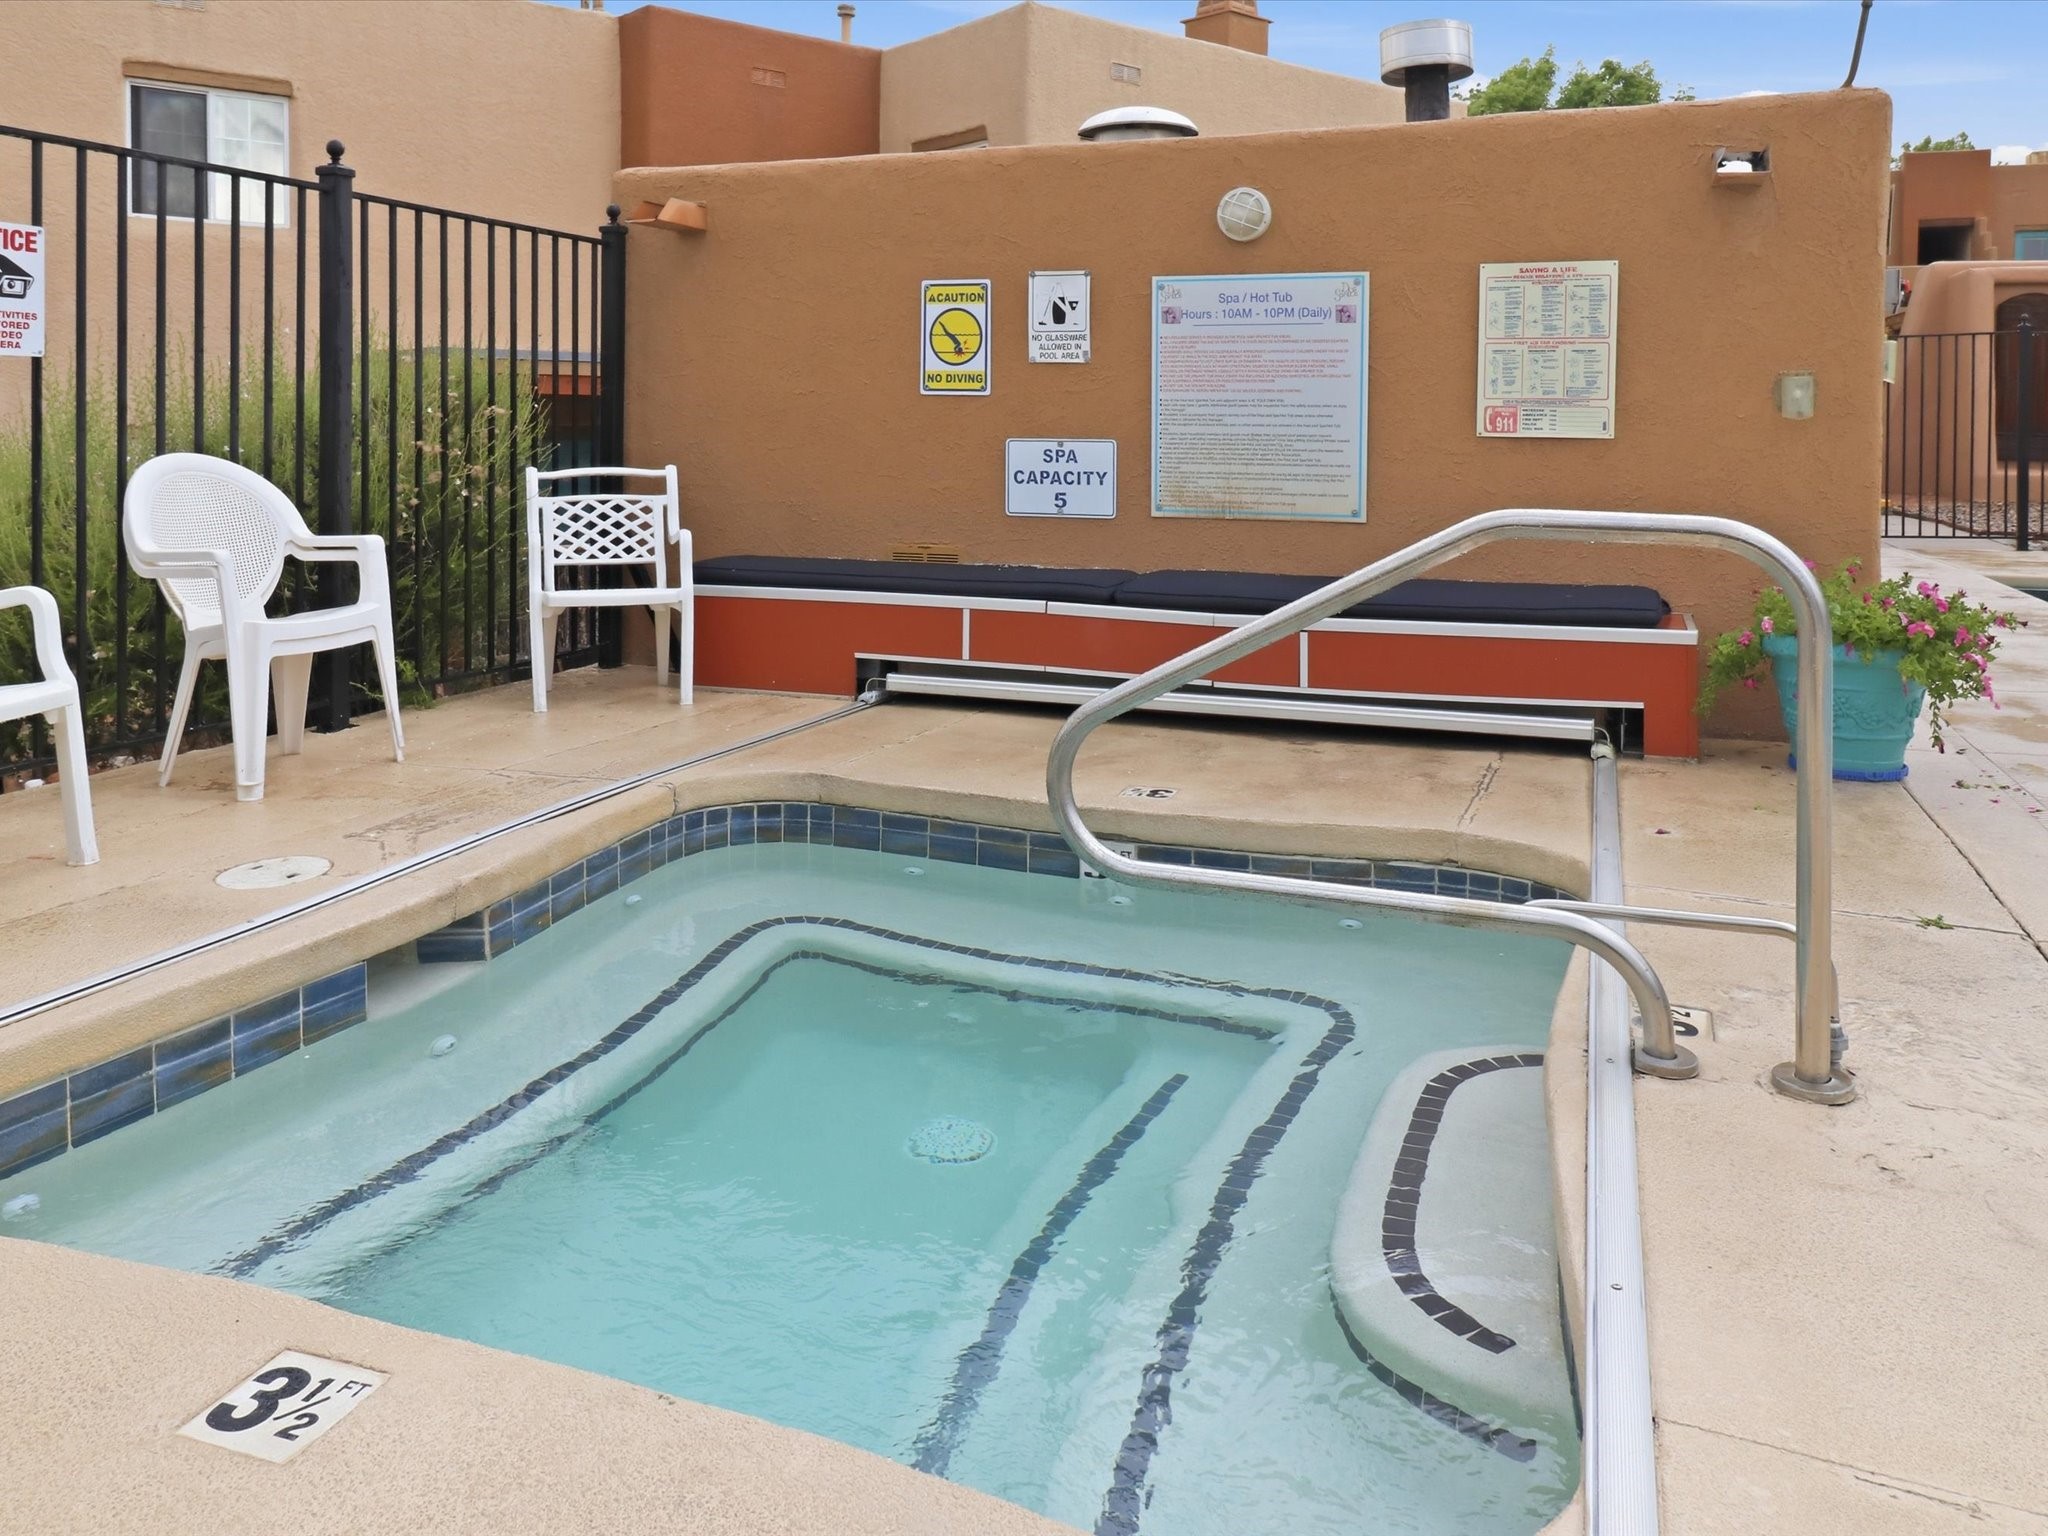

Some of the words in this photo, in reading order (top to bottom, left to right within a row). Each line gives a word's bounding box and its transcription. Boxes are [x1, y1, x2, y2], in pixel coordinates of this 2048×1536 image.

[936, 292, 985, 303] CAUTION
[1218, 293, 1240, 305] Spa
[1242, 293, 1248, 303] /
[1250, 293, 1270, 303] Hot
[1272, 292, 1293, 303] Tub
[1181, 309, 1212, 320] Hours
[1222, 308, 1253, 319] 10AM
[1264, 307, 1295, 318] 10PM
[1298, 307, 1332, 320] (Daily)
[0, 320, 30, 330] ORED
[0, 331, 23, 339] DEO
[1045, 333, 1088, 341] GLASSWARE
[1039, 343, 1072, 351] ALLOWED
[1074, 342, 1082, 350] IN
[1039, 352, 1058, 360] POOL
[1061, 352, 1080, 360] AREA
[927, 373, 942, 384] NO
[946, 373, 984, 384] DIVING
[1496, 416, 1514, 432] 911
[1042, 448, 1078, 464] SPA
[1013, 470, 1108, 486] CAPACITY
[1054, 492, 1067, 508] 5
[336, 1380, 373, 1398] FT
